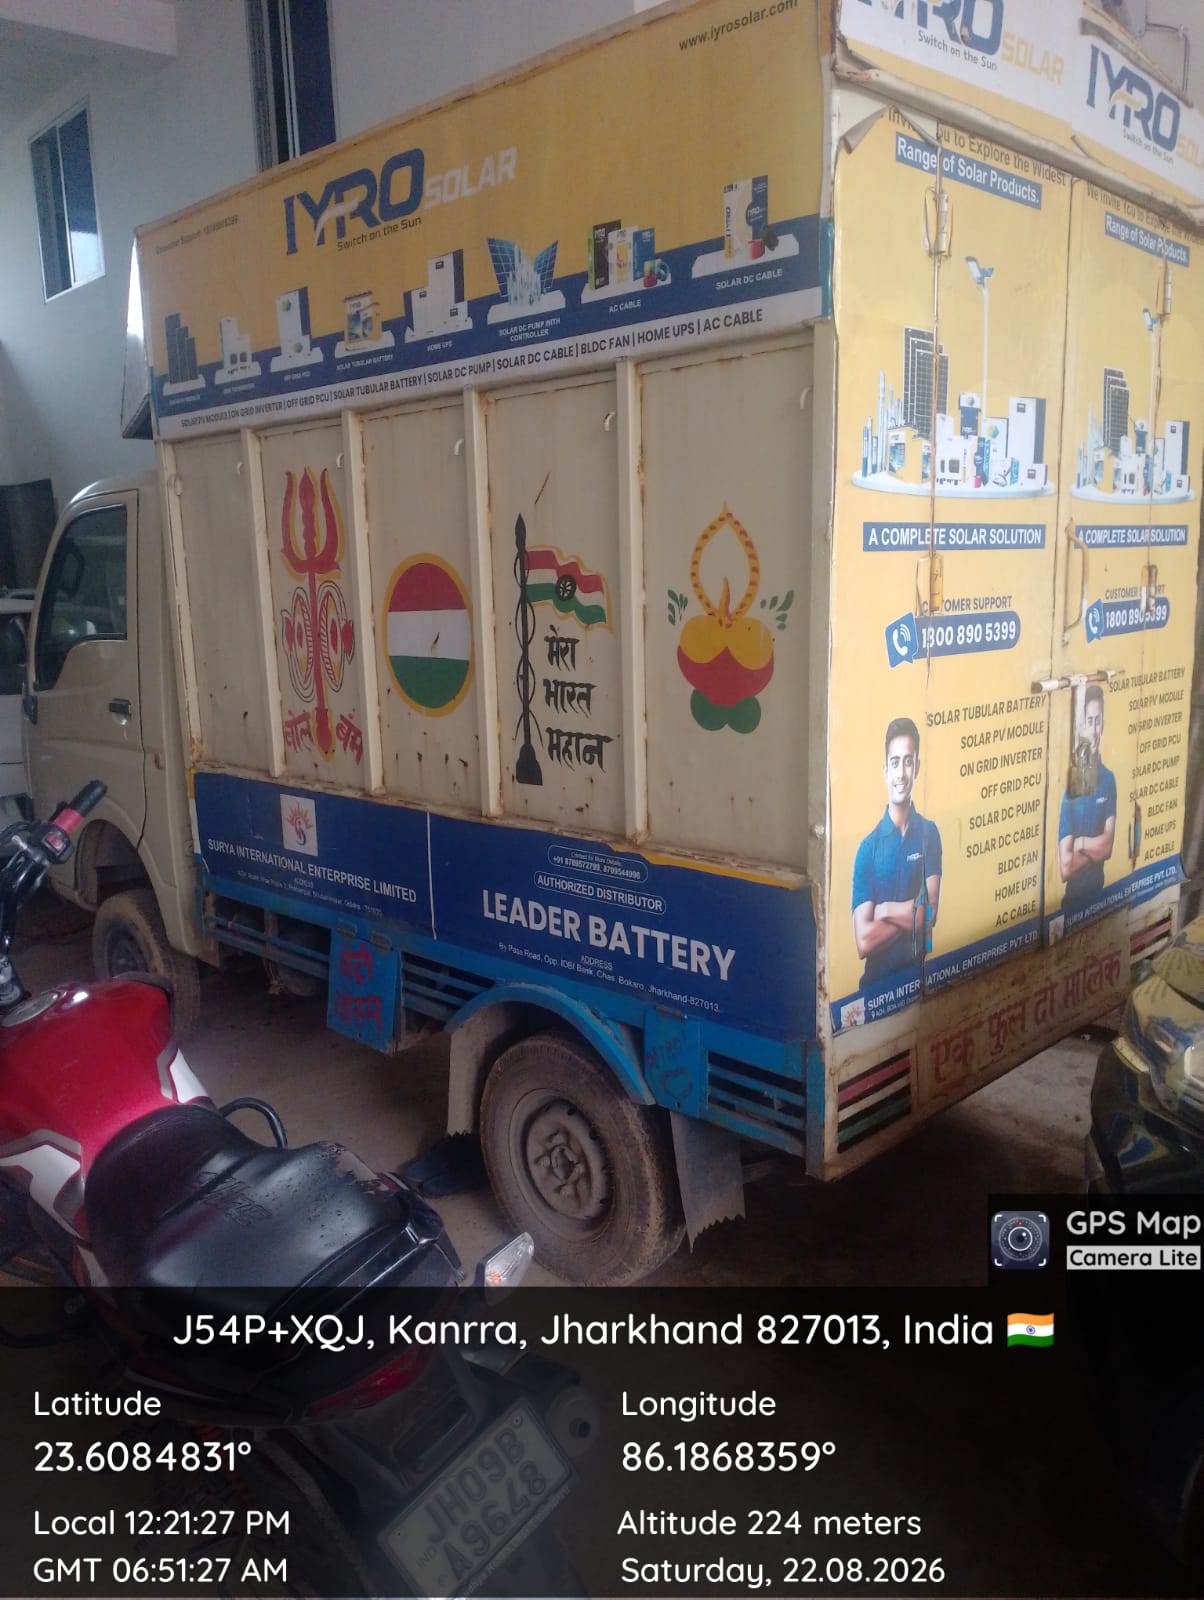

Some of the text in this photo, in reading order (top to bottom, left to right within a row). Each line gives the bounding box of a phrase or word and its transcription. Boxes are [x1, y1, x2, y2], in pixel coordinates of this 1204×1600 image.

[917, 30, 998, 71] Switch on the Sun
[1001, 32, 1064, 84] SOLAR
[1086, 43, 1181, 153] IYRO
[953, 130, 966, 148] to
[969, 135, 1011, 167] Explore
[1013, 155, 1030, 173] the
[896, 136, 1040, 204] Range of Solar Products.
[284, 147, 425, 256] IYRO
[424, 147, 518, 210] SOLAR
[337, 216, 422, 252] Switch on the Sun
[1105, 215, 1130, 240] Range
[1130, 228, 1139, 241] of
[1139, 230, 1157, 250] Solar
[715, 268, 783, 290] SOLAR DC CABLE
[608, 299, 641, 312] AC CABLE
[510, 328, 549, 342] CONTROLLER
[255, 308, 764, 416] INVERTER OFF GRID PCU SOLAR TUBULAR BATTERY SOLAR DC PUMP SOLAR DC CABLE BLDC FAN HOME UPS AC CABLE
[868, 527, 1042, 546] A COMPLETE SOLAR SOLUTION
[1085, 527, 1186, 544] COMPLETE SOLAR SOLUTION
[973, 595, 1013, 609] SUPPORT
[1105, 586, 1138, 600] CUSTOMER
[956, 619, 1017, 645] 890 5399
[1105, 608, 1128, 630] 1800
[544, 624, 580, 672] मेरा
[1108, 667, 1185, 693] SOLAR BATTERY
[926, 693, 1047, 727] SOLAR TUBULAR BATTERY
[1159, 689, 1184, 705] MODULE
[960, 720, 1044, 750] SOLAR PV MODULE
[1127, 712, 1182, 735] ON INVERTER
[545, 726, 614, 773] महान
[1140, 732, 1182, 754] OFF GRID PCU
[959, 747, 1043, 777] ON GRID INVERTER
[1132, 754, 1180, 779] SOLAR DC PUMP
[981, 773, 1042, 799] OFF GRID PCU
[1149, 776, 1179, 796] DC CABLE
[969, 798, 1041, 830] SOLAR DC PUMP
[1148, 799, 1178, 818] BLDC FAN
[966, 824, 1040, 858] SOLAR DC CABLE
[1144, 819, 1176, 840] HOME UPS
[998, 850, 1039, 875] BLDC FAN
[1144, 841, 1175, 861] AC CABLE
[207, 838, 236, 855] SURYA
[236, 846, 306, 875] INTERNATIONAL
[308, 863, 372, 892] ENTERPRISE
[373, 879, 417, 903] LIMITED
[537, 874, 664, 912] AUTHORIZED DISTRIBUTOR
[994, 875, 1037, 902] HOME UPS
[995, 900, 1036, 928] AC CABLE
[482, 889, 736, 982] LEADER BATTERY
[498, 942, 523, 957] By Pass
[581, 955, 613, 971] ADDRESS
[868, 990, 895, 1011] SURYA
[961, 944, 1009, 971] ENTERPRISE
[932, 1019, 984, 1083] एक
[1034, 978, 1057, 1026] दो
[1063, 953, 1121, 1010] मालिक
[424, 1427, 525, 1544] JH09B
